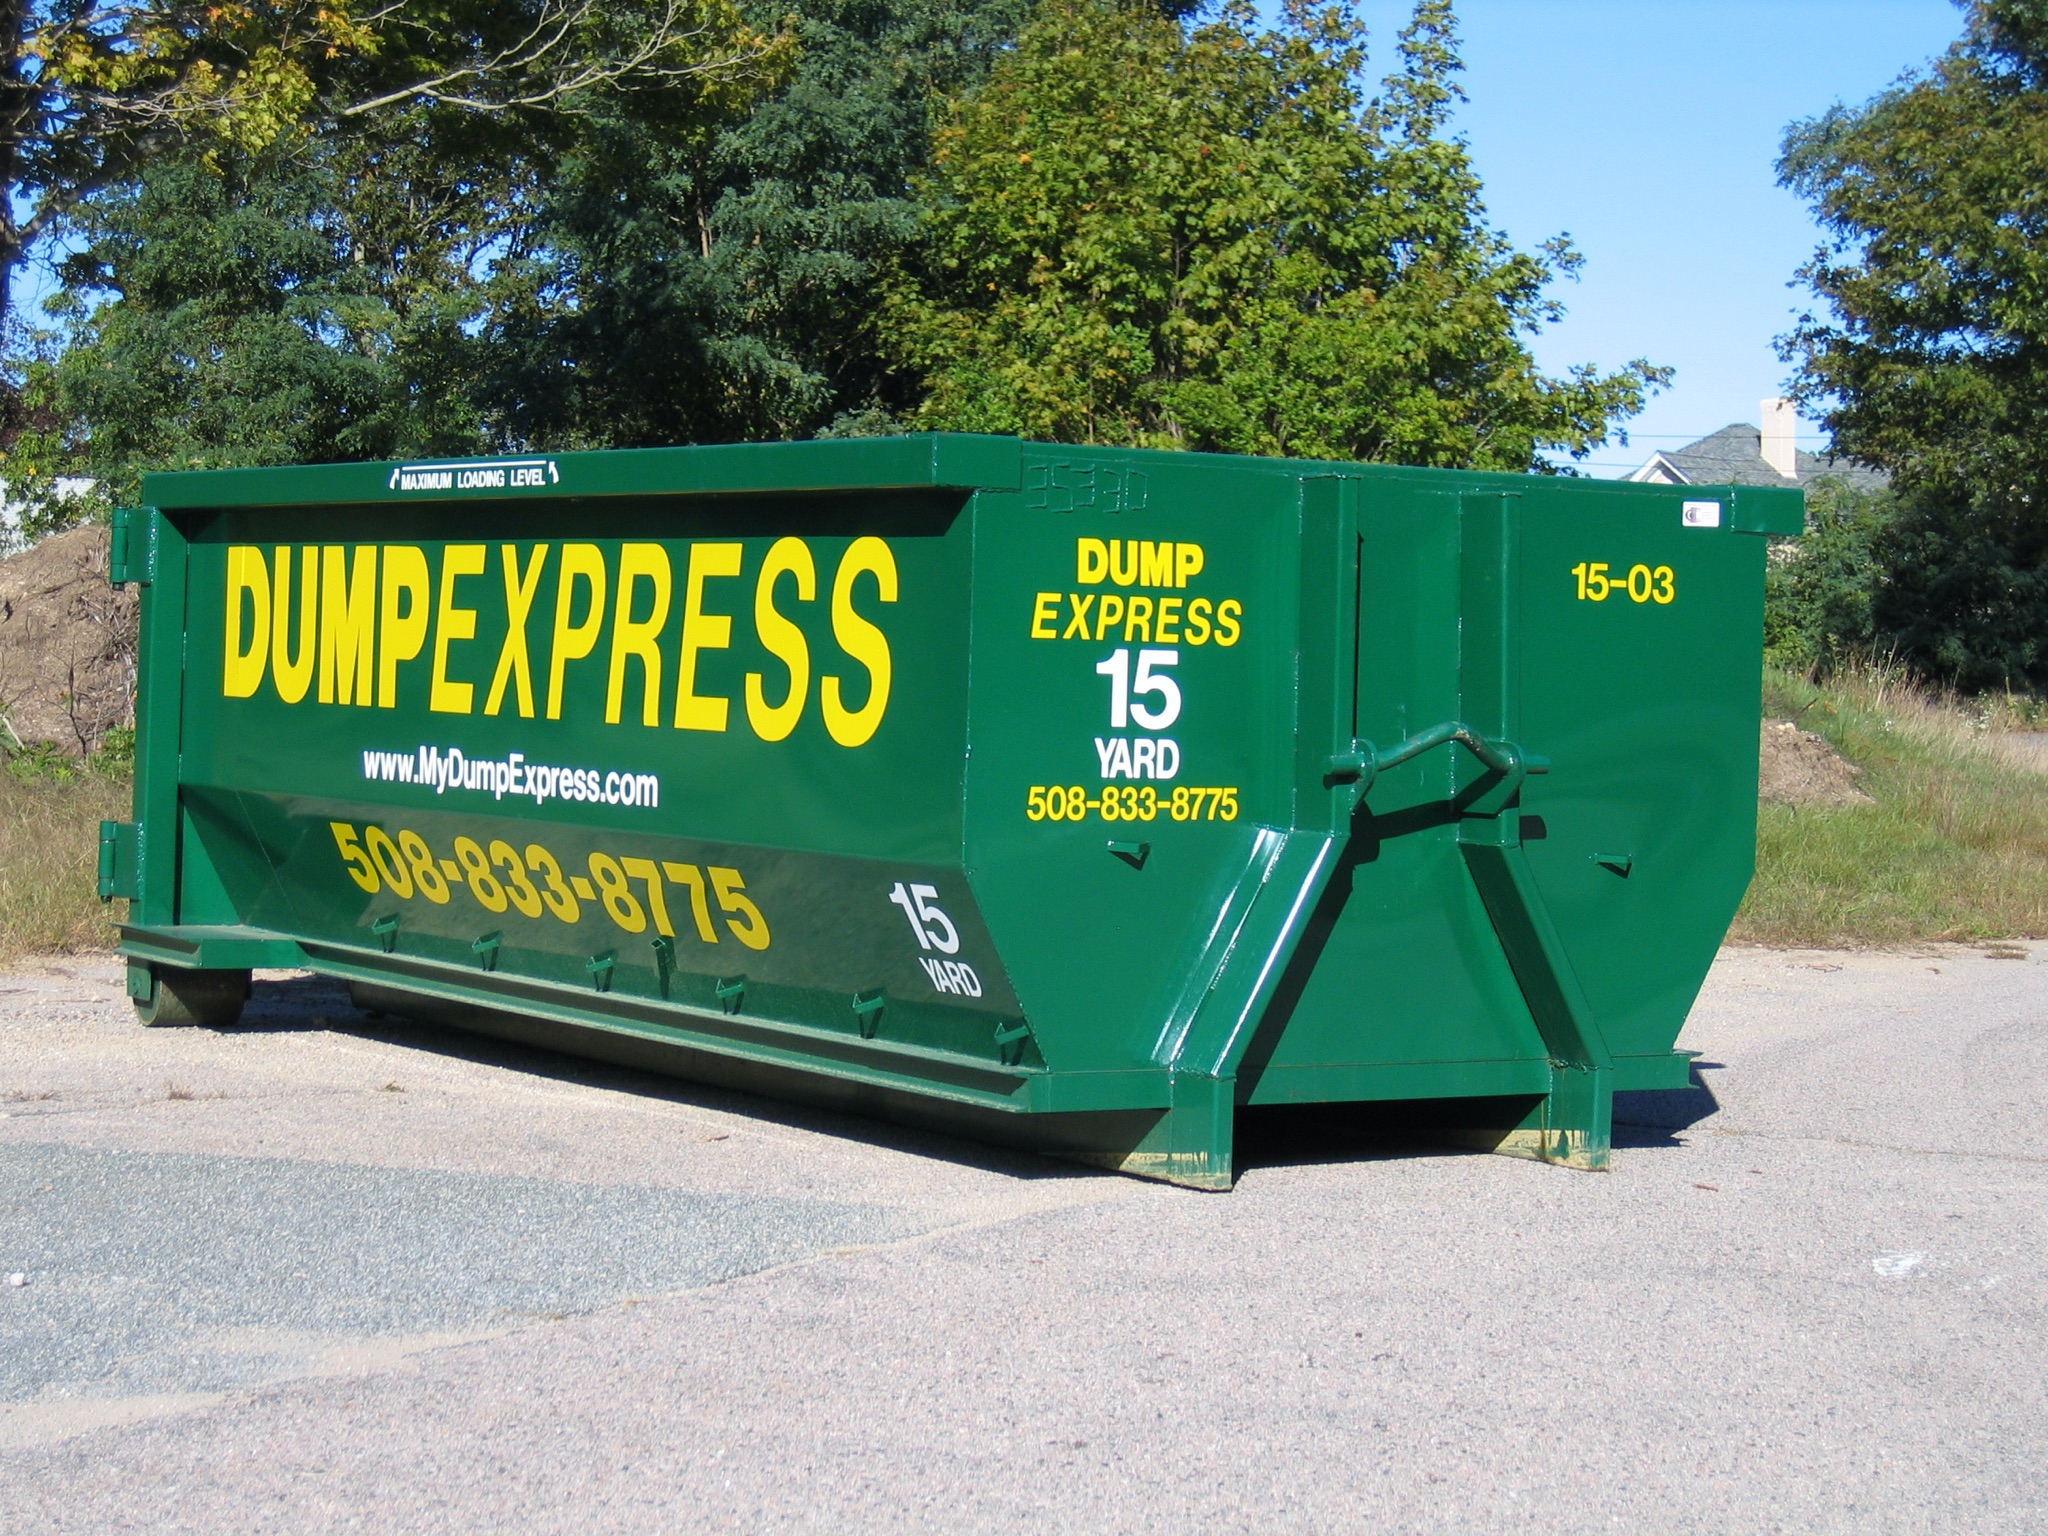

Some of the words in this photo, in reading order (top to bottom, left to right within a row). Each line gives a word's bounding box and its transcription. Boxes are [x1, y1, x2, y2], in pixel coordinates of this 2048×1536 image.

[401, 471, 452, 490] MAXIMUM
[457, 469, 505, 488] LOADING
[510, 468, 546, 486] LEVEL
[1077, 537, 1205, 588] DUMP
[1571, 562, 1676, 605] 15-03
[1030, 592, 1243, 647] EXPRESS
[1095, 648, 1182, 731] 15
[363, 745, 659, 808] www.MyDumpExpress.com
[1095, 738, 1181, 780] YARD
[1026, 785, 1239, 823] 508-833-8775
[330, 822, 771, 951] 508-833-8775
[888, 882, 960, 955] 15
[918, 957, 983, 999] YARD
